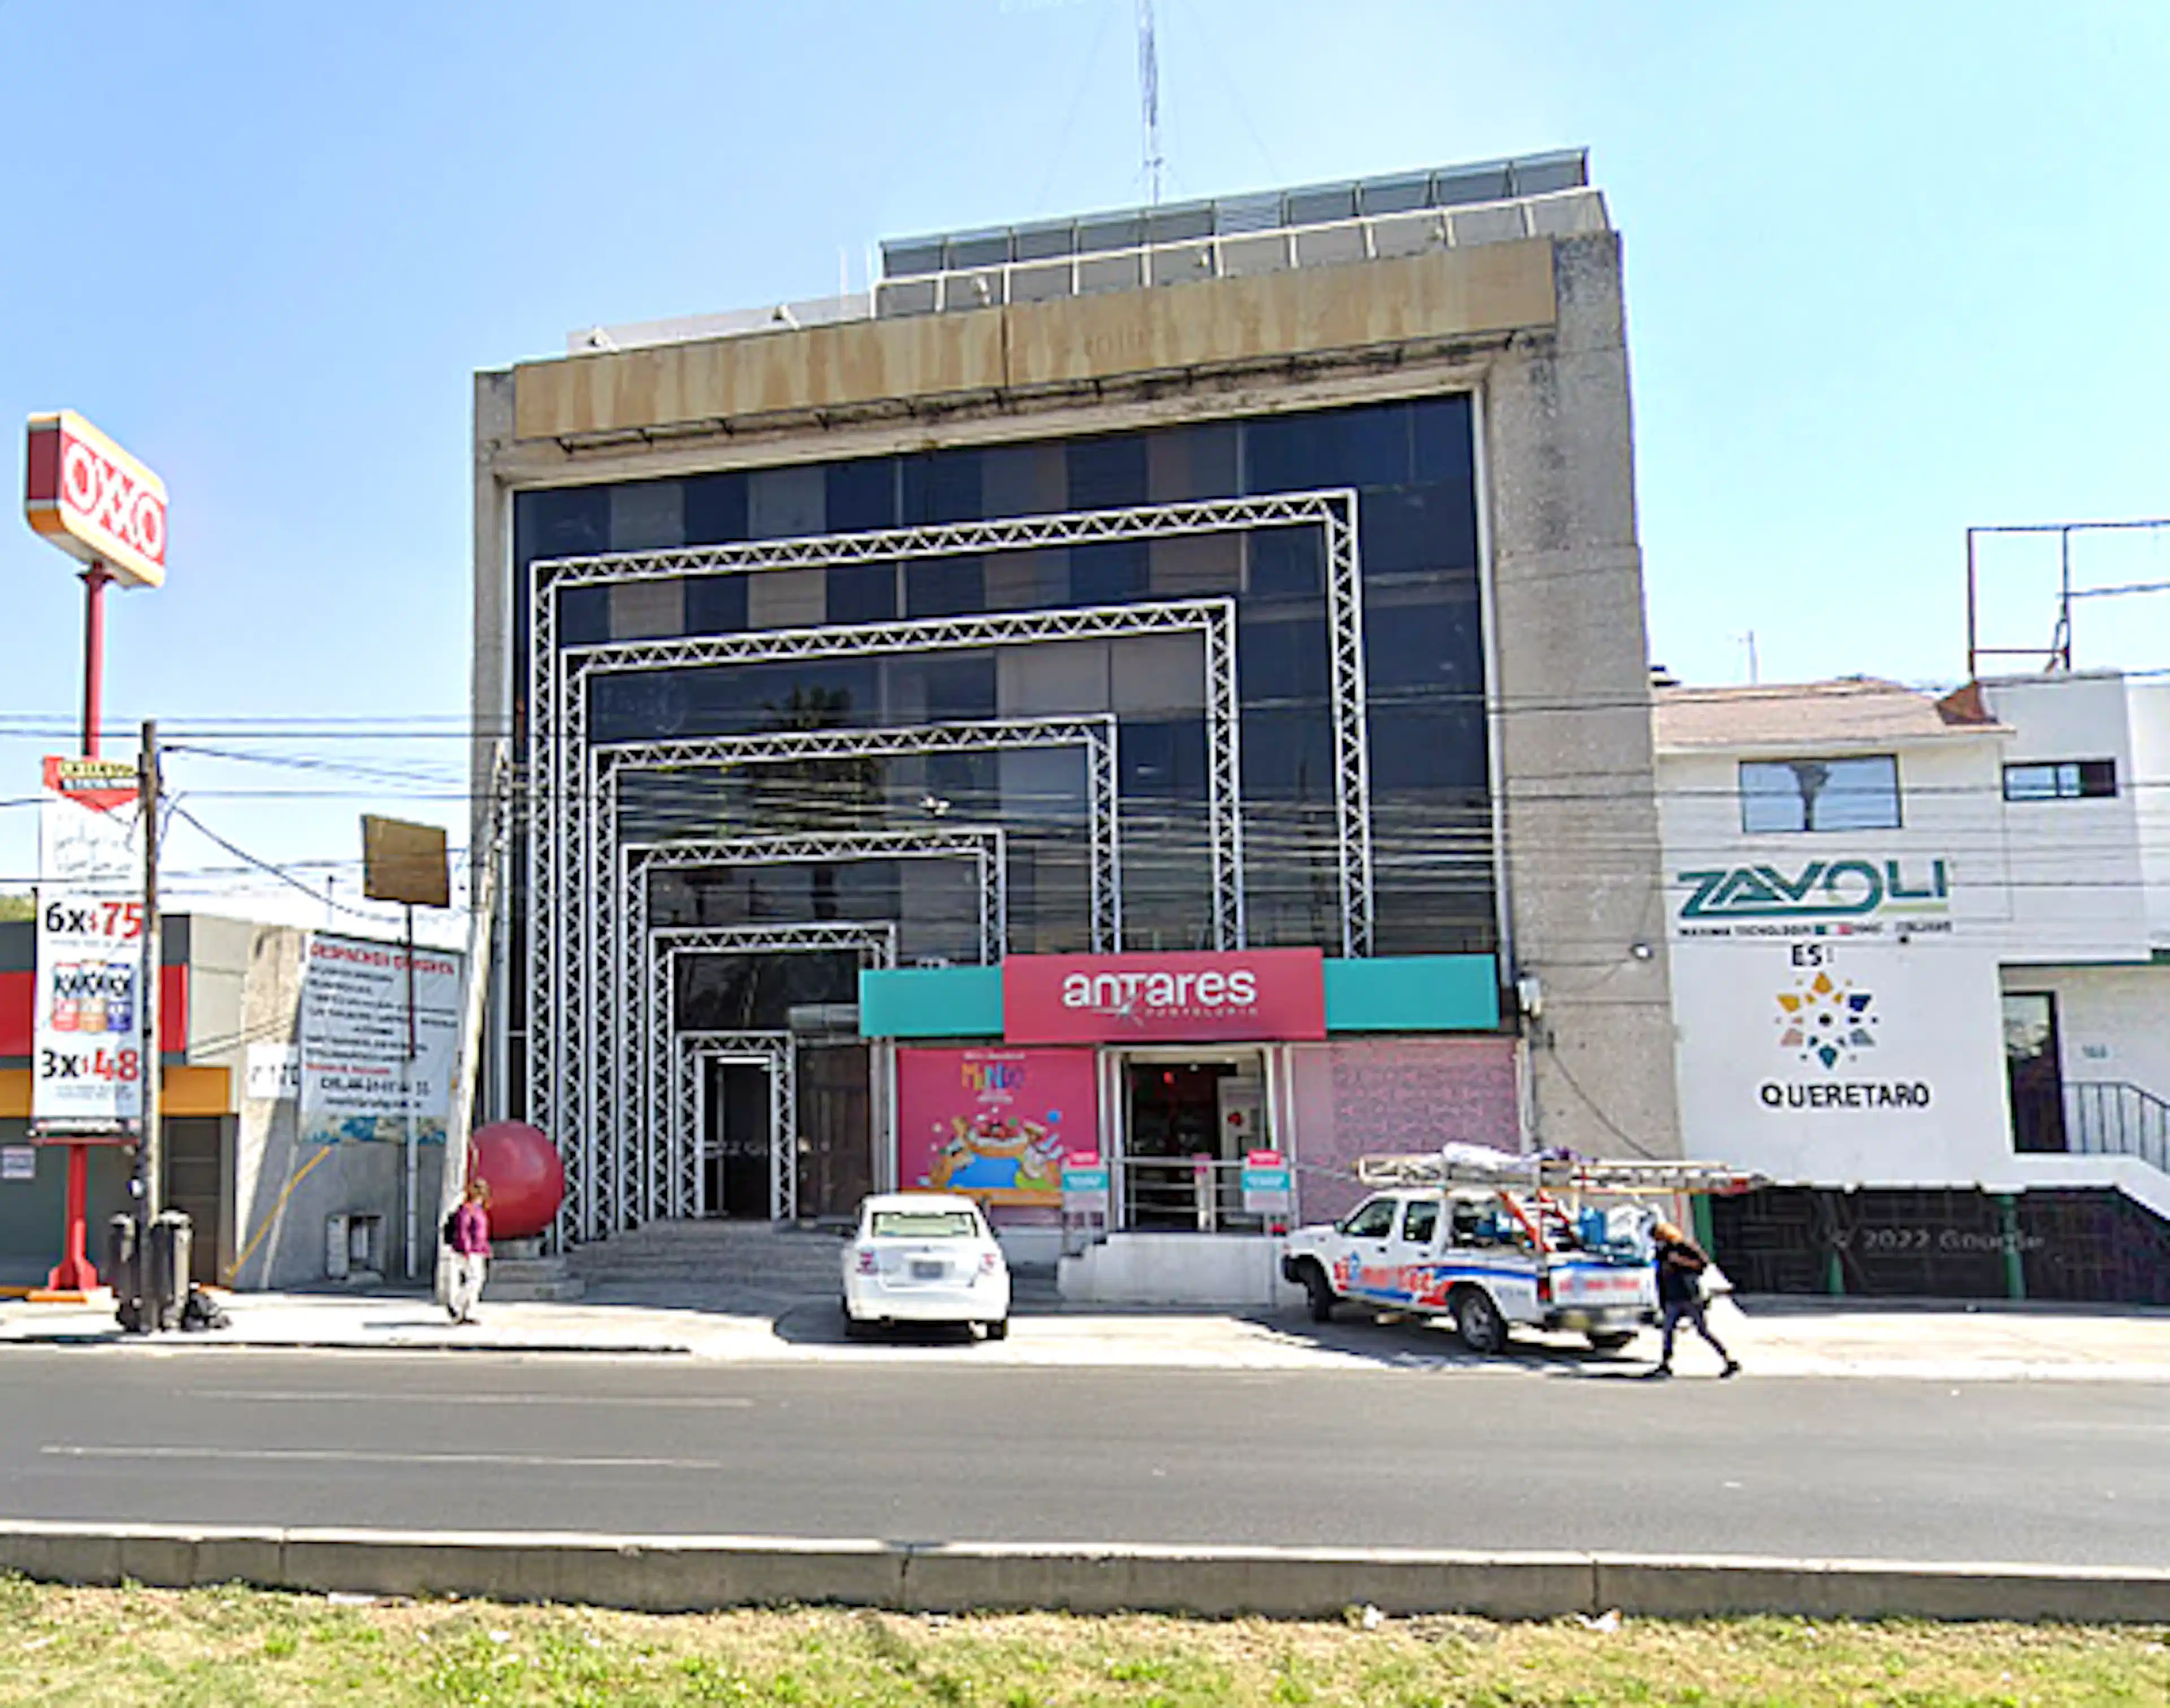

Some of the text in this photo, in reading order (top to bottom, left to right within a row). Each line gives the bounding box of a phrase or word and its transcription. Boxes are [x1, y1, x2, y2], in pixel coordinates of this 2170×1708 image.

[64, 442, 162, 557] OXXO
[1678, 859, 1947, 917] ZAVOLI
[1761, 1083, 1929, 1109] QUERETARO
